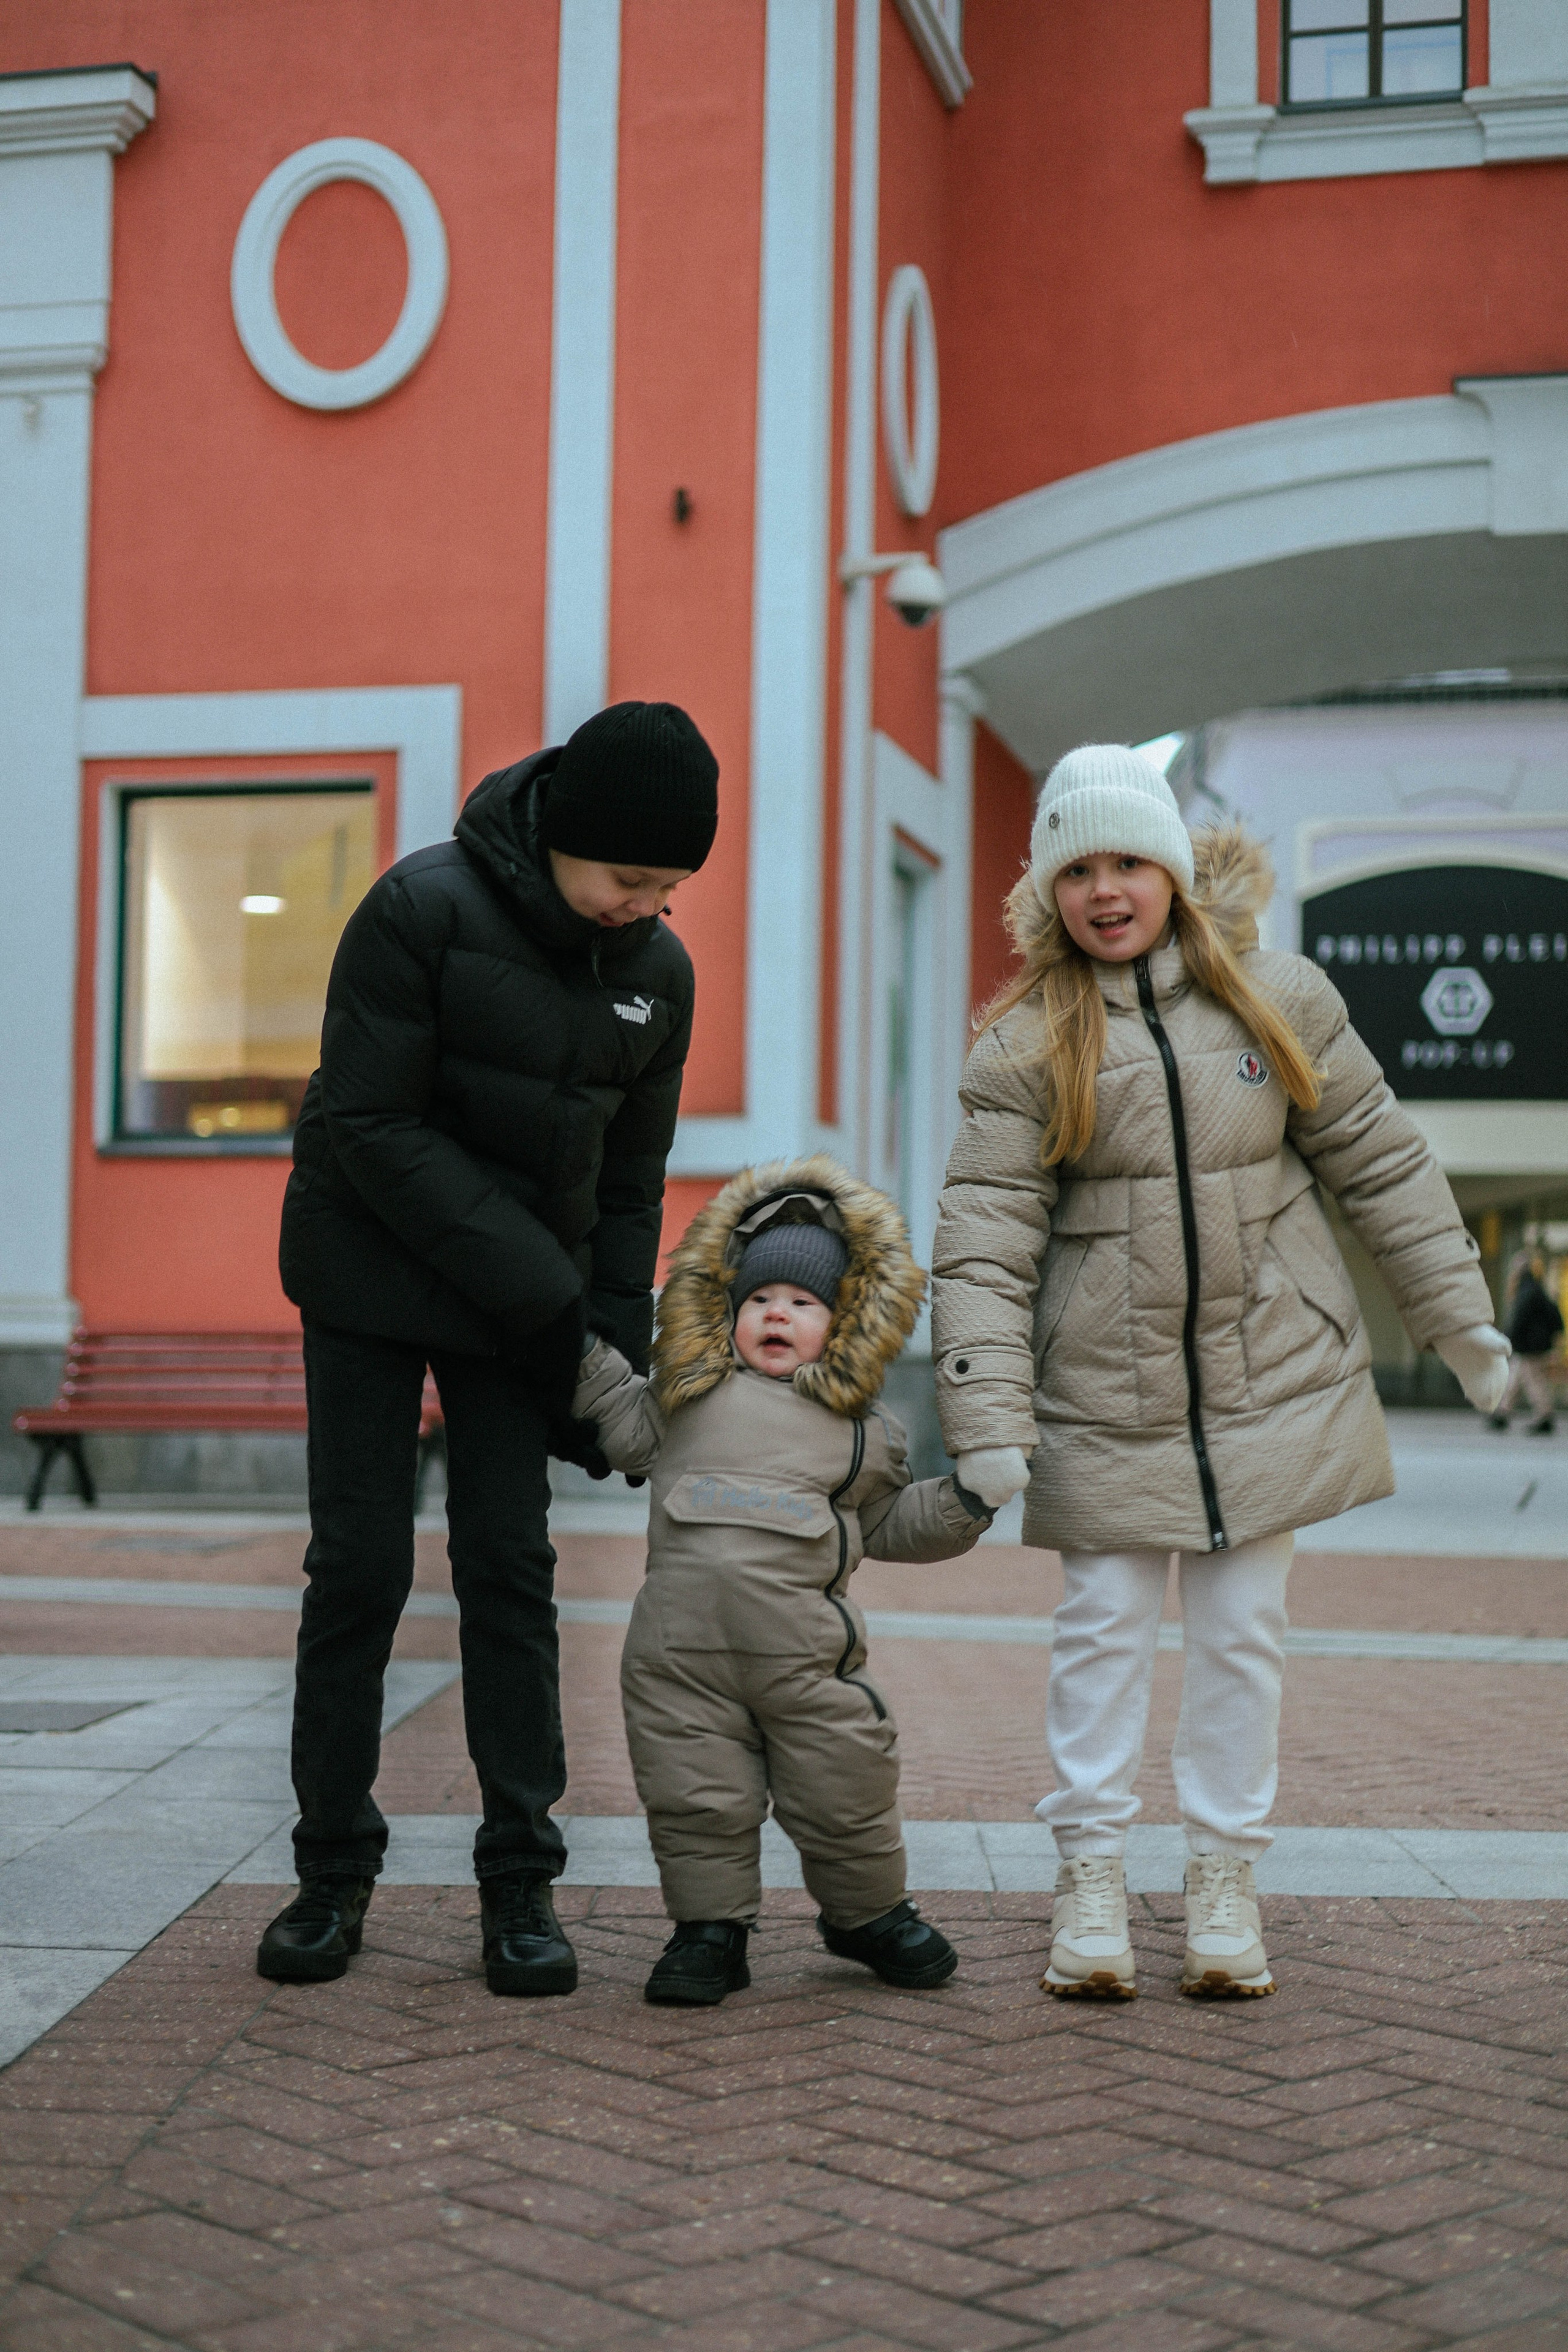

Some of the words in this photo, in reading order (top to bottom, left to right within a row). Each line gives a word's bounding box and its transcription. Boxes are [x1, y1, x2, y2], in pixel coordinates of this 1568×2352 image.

[1316, 934, 1466, 964] PHILIPP
[613, 1003, 647, 1025] PUMA
[721, 1486, 772, 1510] Hello
